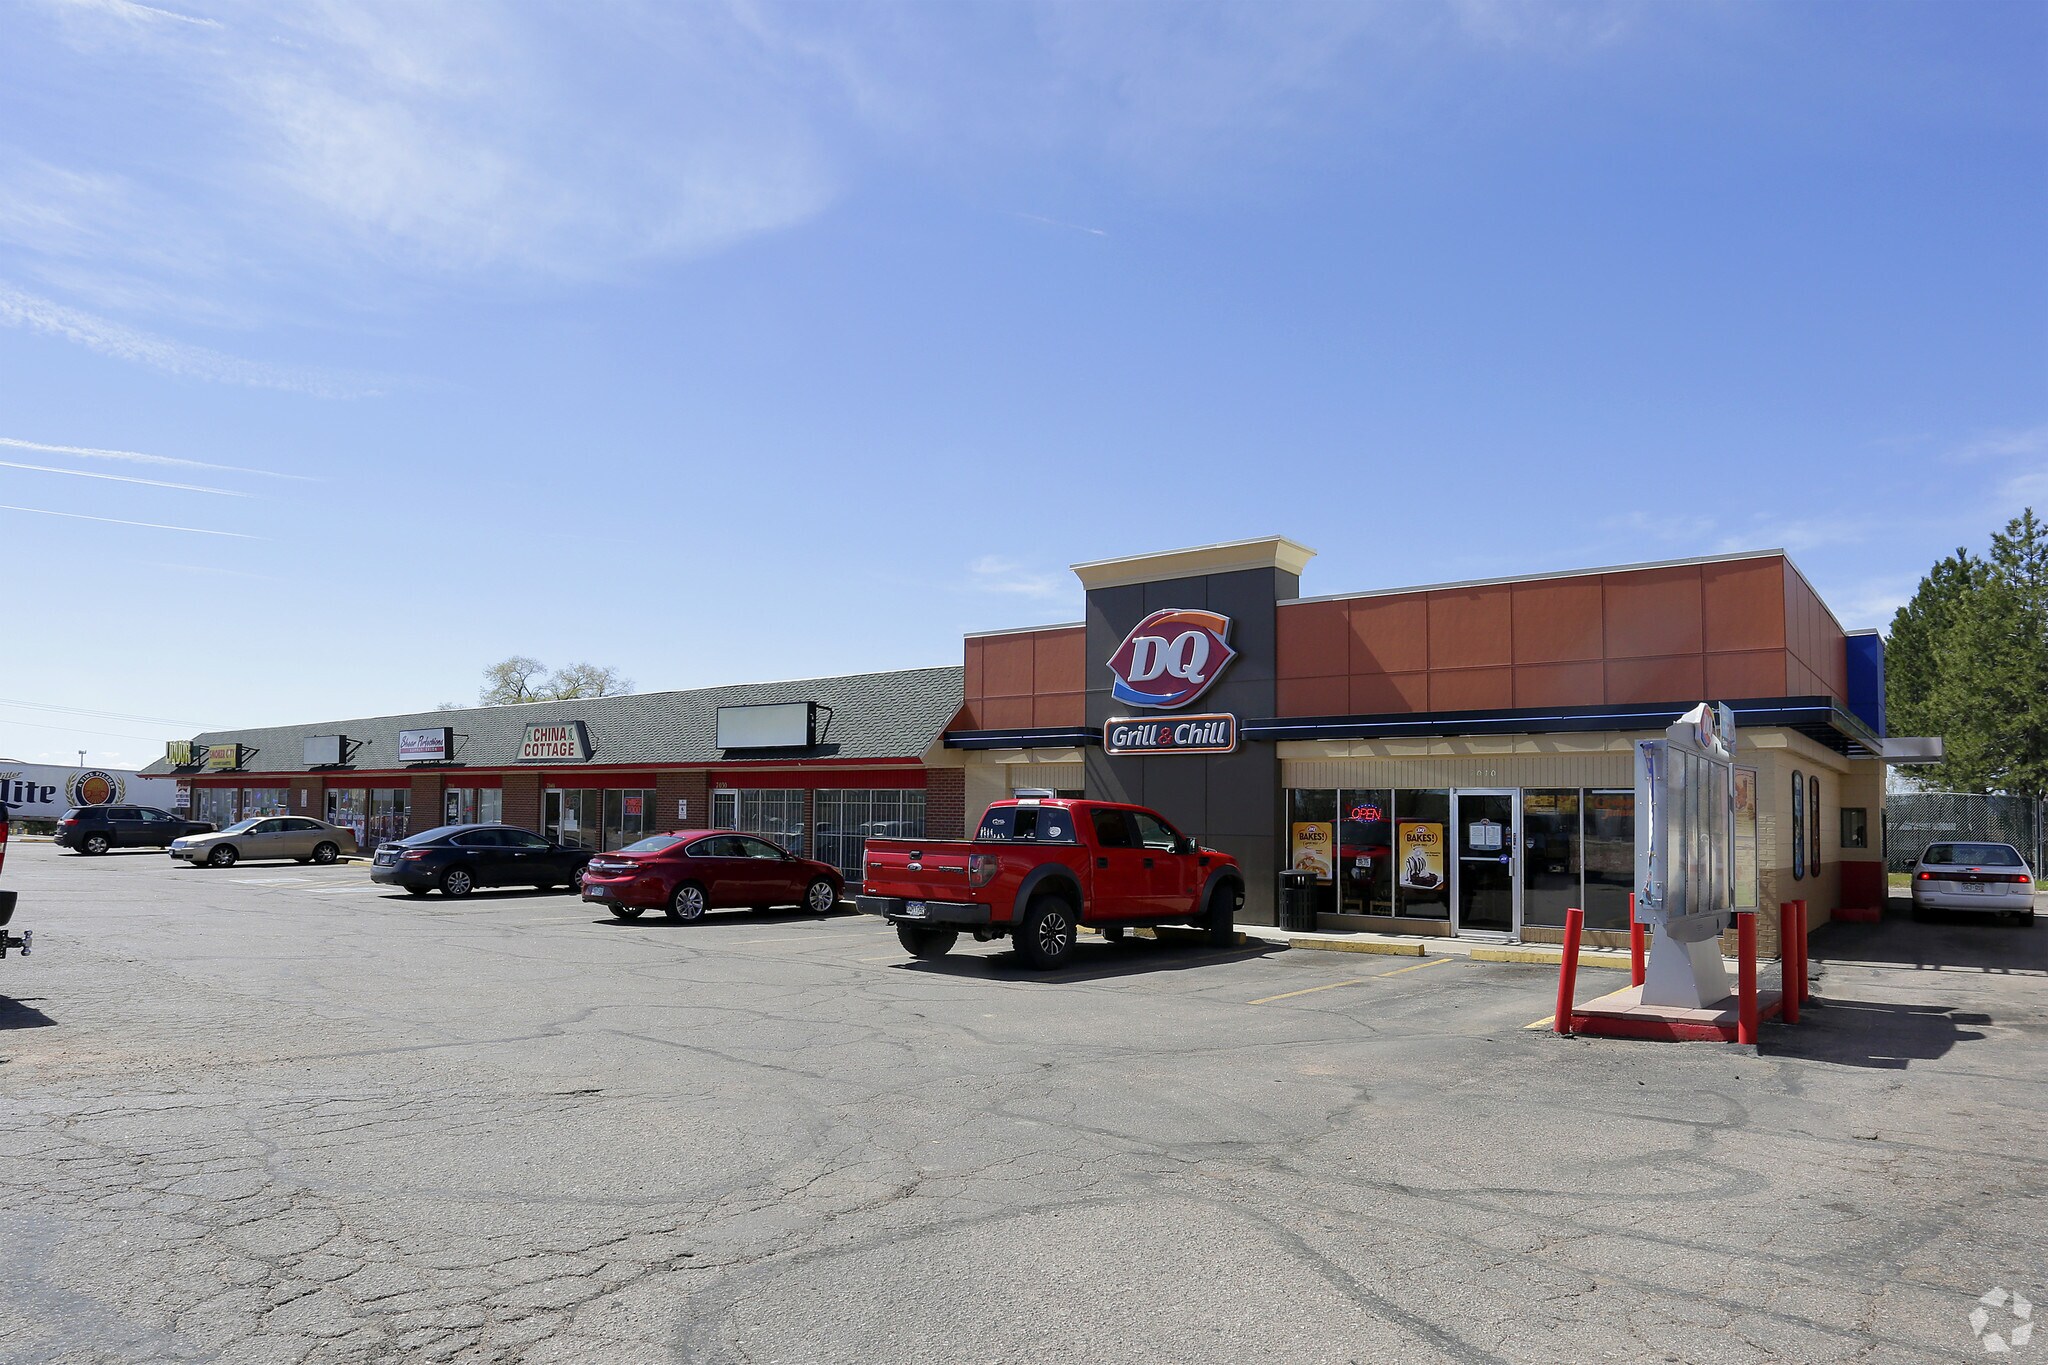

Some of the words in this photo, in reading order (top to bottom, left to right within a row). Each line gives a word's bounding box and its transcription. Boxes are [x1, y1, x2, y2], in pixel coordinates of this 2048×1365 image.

[1127, 630, 1210, 684] DQ
[533, 727, 567, 742] CHINA
[1112, 724, 1158, 747] Grill
[1158, 727, 1173, 745] &
[1174, 721, 1226, 745] Chill
[524, 742, 575, 757] COTTAGE
[0, 771, 23, 780] iller
[0, 779, 57, 809] Lite
[1351, 807, 1382, 820] OPEN
[1299, 832, 1325, 841] BAKES!
[1406, 833, 1435, 842] BAKES!
